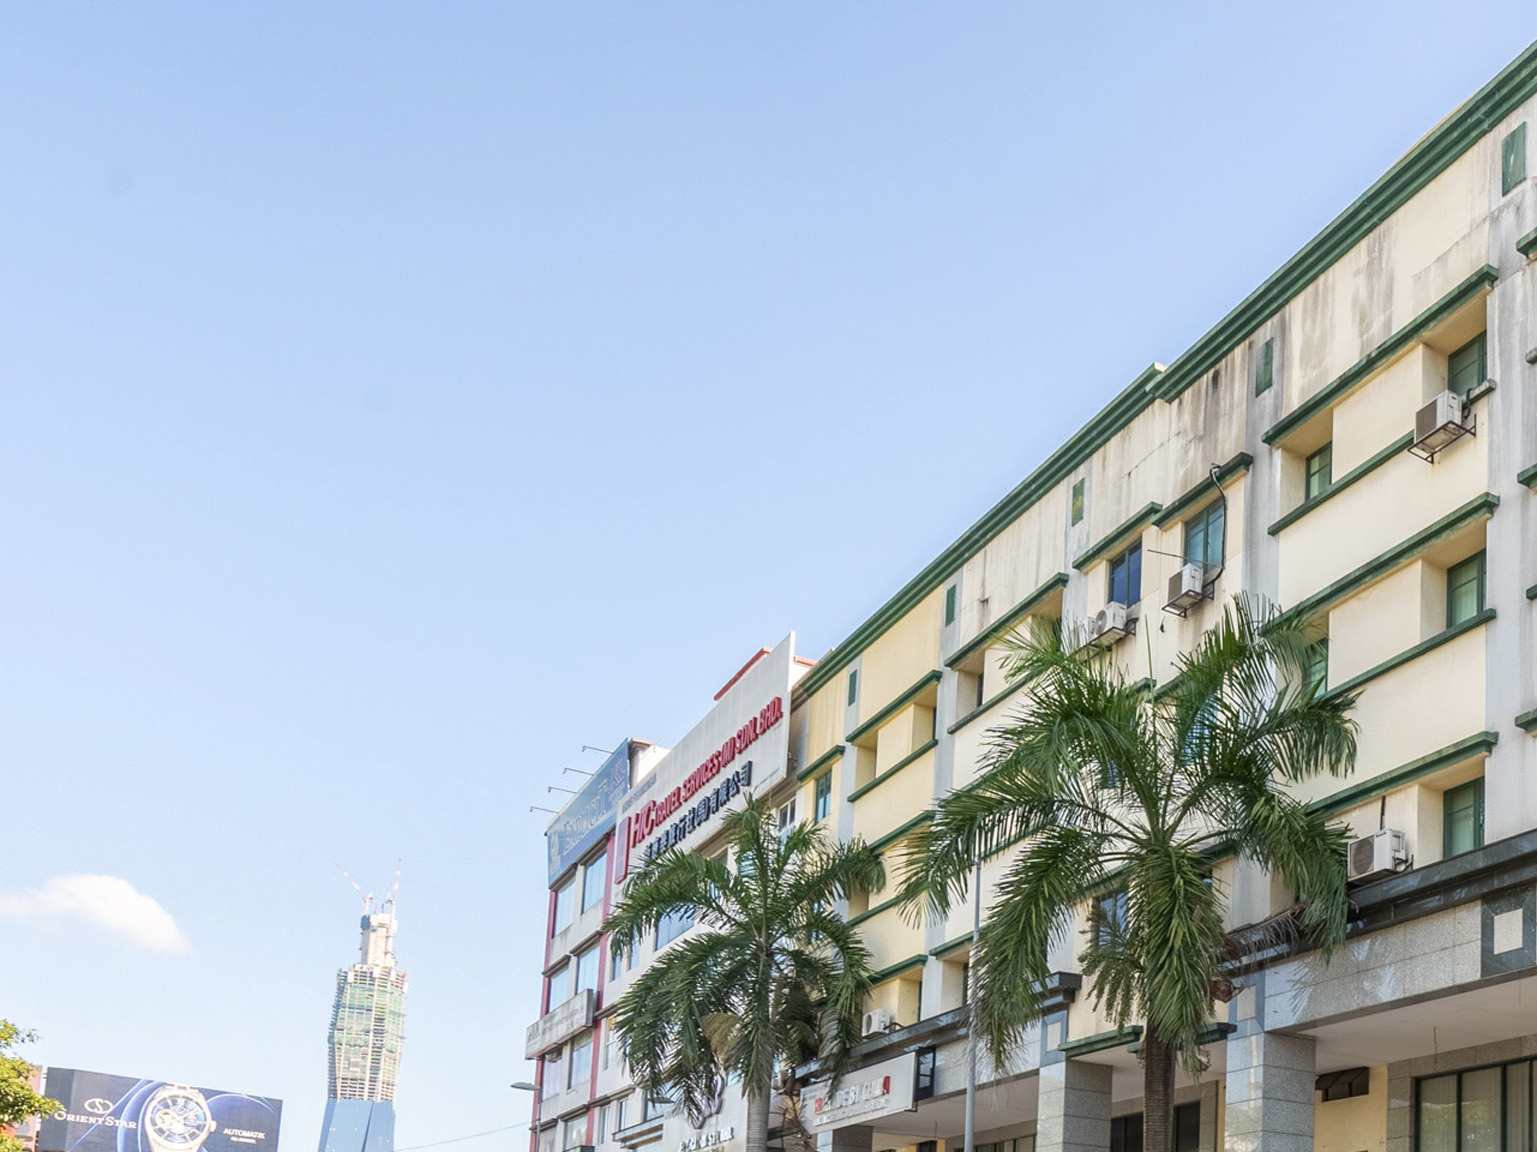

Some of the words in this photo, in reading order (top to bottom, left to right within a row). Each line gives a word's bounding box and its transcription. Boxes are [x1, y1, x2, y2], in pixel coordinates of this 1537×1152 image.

[682, 750, 721, 803] SERVICES
[54, 1110, 104, 1125] ORIENT
[104, 1115, 137, 1129] STAR
